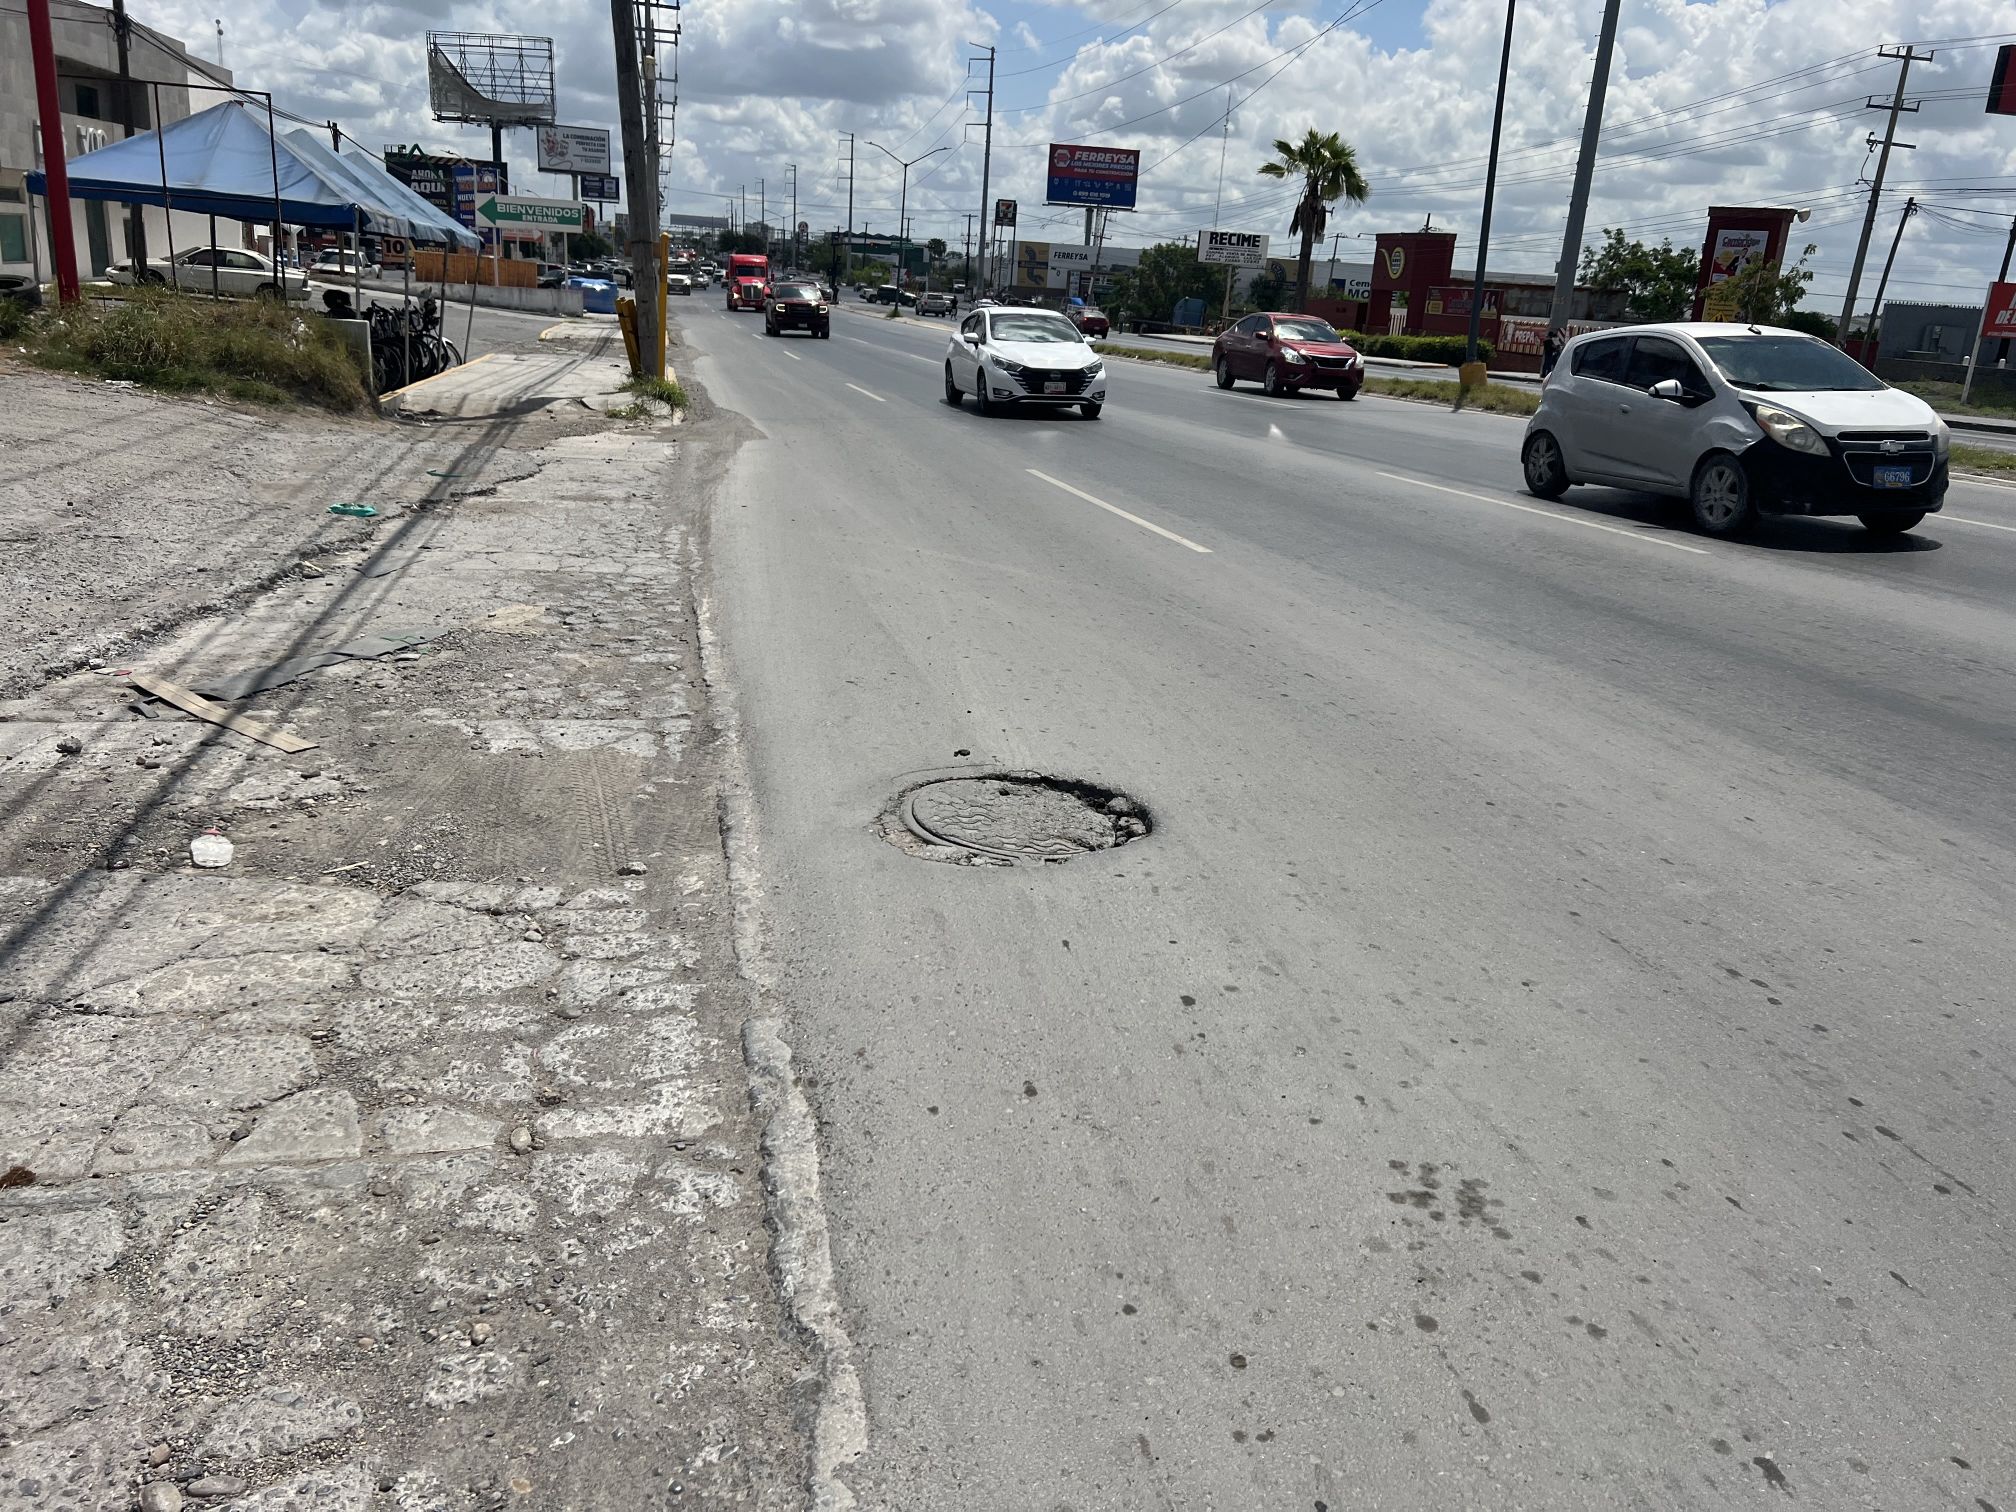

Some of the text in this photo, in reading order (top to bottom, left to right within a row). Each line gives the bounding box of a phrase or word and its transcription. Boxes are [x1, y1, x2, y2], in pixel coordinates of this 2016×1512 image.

[1074, 151, 1135, 164] FERREYSA
[497, 203, 579, 218] BIENVENIDOS
[522, 214, 558, 223] ENTRADA
[1209, 232, 1260, 247] RECIME
[384, 240, 405, 254] 10
[1053, 251, 1088, 261] FERREYSA
[1347, 289, 1370, 299] MO
[1514, 330, 1535, 343] PREPA
